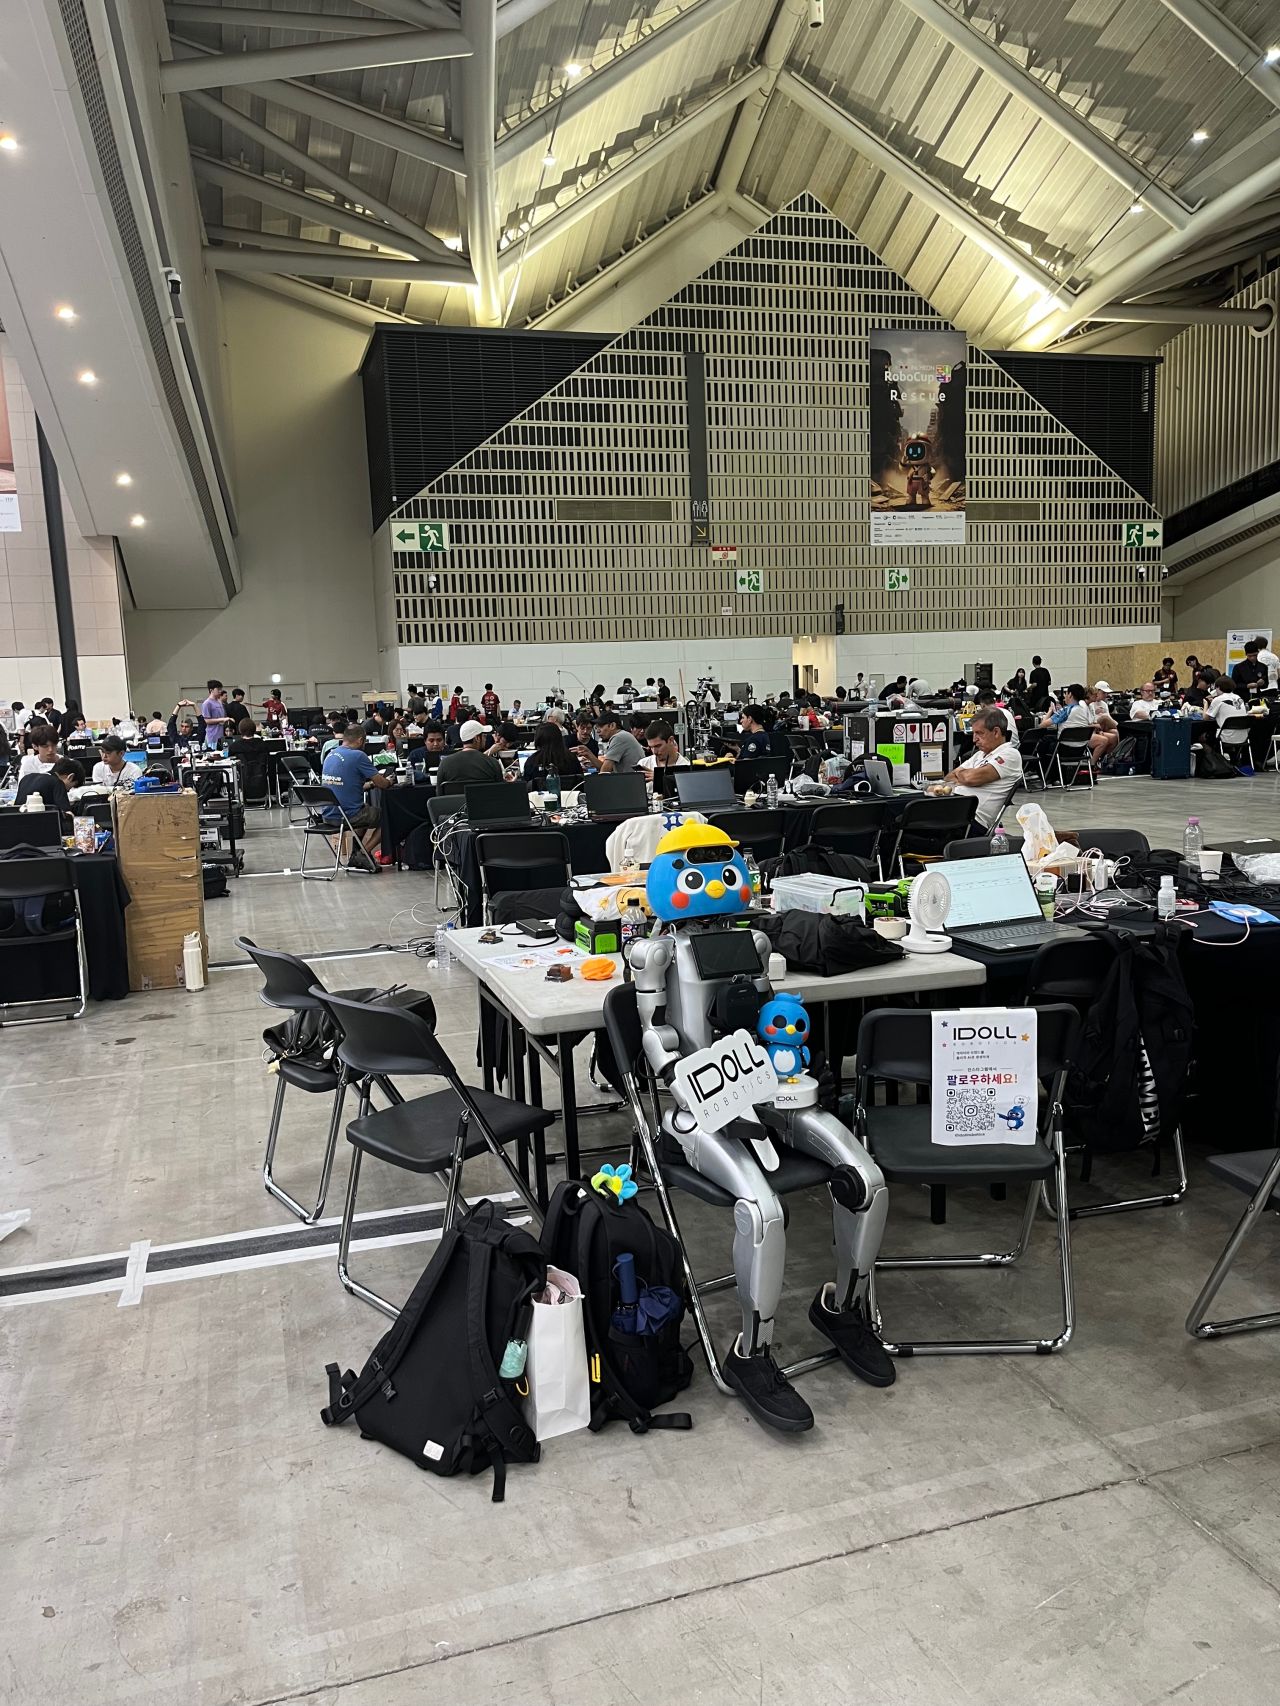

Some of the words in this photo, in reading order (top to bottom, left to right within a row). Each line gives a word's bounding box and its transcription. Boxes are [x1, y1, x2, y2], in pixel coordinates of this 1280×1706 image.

[884, 371, 935, 384] RoboCup
[890, 389, 946, 402] Rescue
[953, 1026, 1017, 1041] IDOLL
[687, 1043, 765, 1104] IDOLL
[946, 1073, 1018, 1086] 팔로우하세요!
[703, 1071, 771, 1118] ROBOTICS
